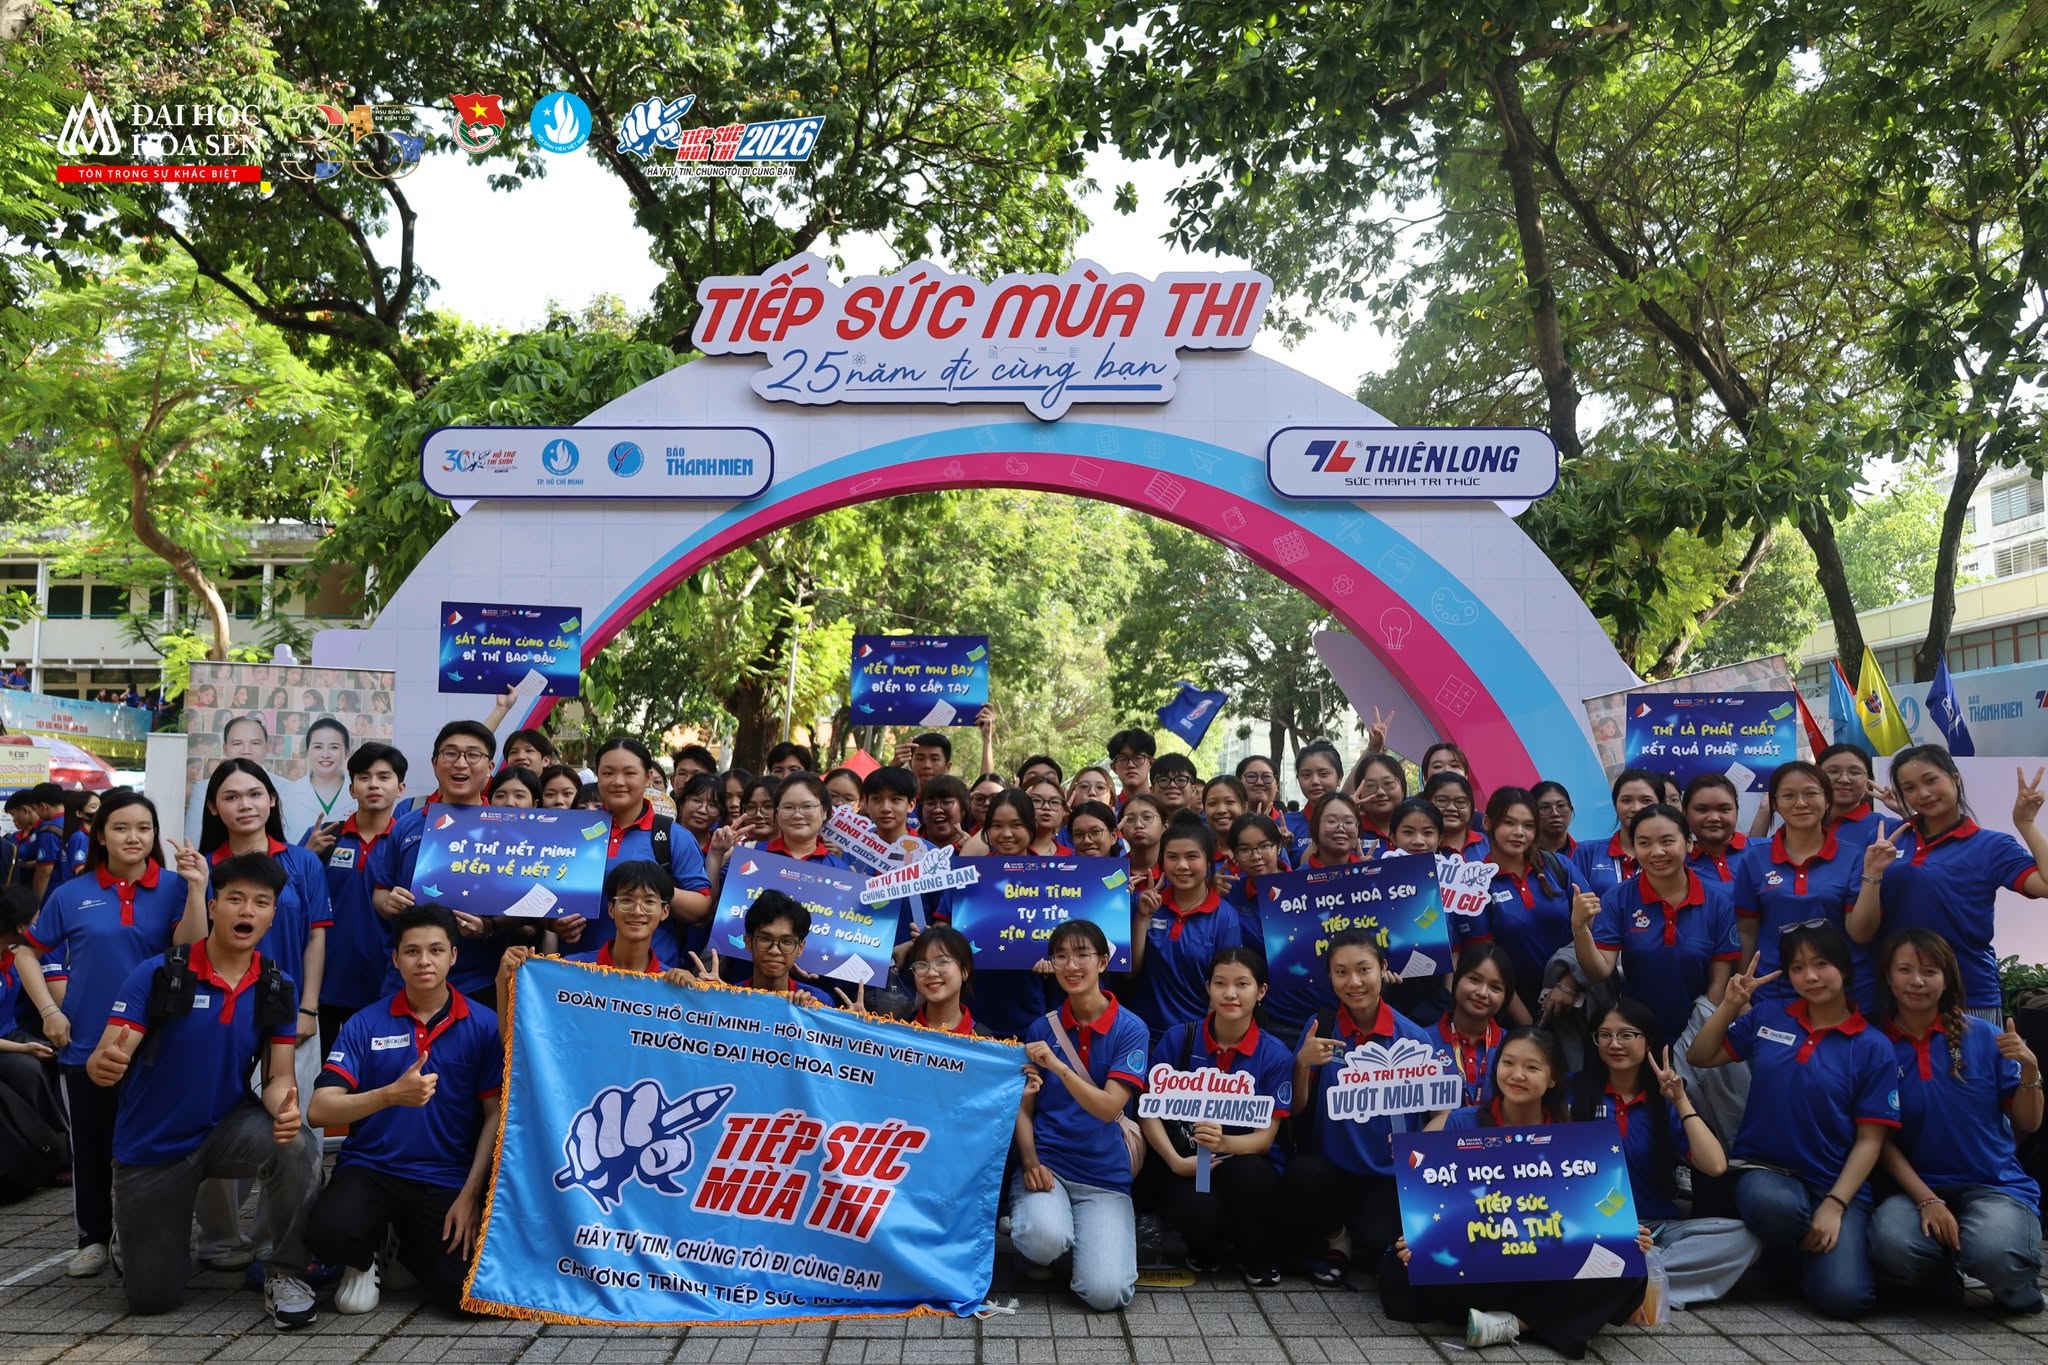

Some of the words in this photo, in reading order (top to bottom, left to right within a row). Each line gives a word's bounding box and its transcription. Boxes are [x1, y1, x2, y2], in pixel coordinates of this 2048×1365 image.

[701, 263, 825, 342] TIẾP
[835, 271, 976, 341] SỨC
[981, 271, 1148, 339] MÙA
[1164, 281, 1262, 337] THI
[767, 348, 848, 393] 25
[846, 362, 927, 383] năm
[939, 347, 977, 384] đi
[991, 355, 1090, 408] cùng
[1094, 342, 1168, 383] bạn
[666, 446, 685, 457] BÁO
[1345, 476, 1370, 487] SỨC
[1374, 478, 1416, 488] MẠNH
[1420, 478, 1442, 487] TRI
[1446, 476, 1481, 487] THỨC
[505, 651, 529, 664] BAO
[950, 664, 975, 678] BAY
[904, 682, 916, 693] 10
[947, 682, 971, 696] TAY
[1680, 721, 1696, 737] LÀ
[1740, 719, 1777, 737] CHẤT
[1641, 740, 1666, 757] KẾT
[1744, 739, 1781, 757] NHẤT
[505, 839, 535, 858] HẾT
[540, 844, 577, 860] MÌNH
[833, 819, 862, 840] BÌNH
[861, 834, 888, 855] TĨNH
[521, 860, 550, 880] HẾT
[886, 885, 900, 898] TÔI
[901, 883, 911, 895] ĐI
[913, 877, 943, 894] CÙNG
[945, 867, 976, 890] BẠN
[895, 864, 920, 883] TIN
[1004, 883, 1040, 900] BÌNH
[1315, 893, 1345, 911] HỌC
[1351, 889, 1383, 905] HOA
[1388, 884, 1418, 900] SEN
[1441, 887, 1457, 908] HI
[1457, 890, 1487, 913] CỬ
[1321, 913, 1351, 934] TIẾP
[557, 989, 608, 1011] ĐOÀN
[610, 998, 653, 1019] TNCS
[656, 1002, 682, 1023] HỒ
[685, 1005, 715, 1027] CHÍ
[717, 1013, 761, 1035] MINH
[773, 1020, 804, 1044] HỘI
[804, 1028, 845, 1050] SINH
[846, 1036, 885, 1059] VIÊN
[886, 1043, 925, 1069] VIỆT
[925, 1054, 967, 1075] NAM
[629, 1028, 710, 1058] TRƯỜNG
[712, 1041, 749, 1069] ĐẠI
[750, 1047, 792, 1074] HỌC
[794, 1054, 836, 1080] HOA
[837, 1062, 876, 1087] SEN
[1153, 1067, 1206, 1095] Good
[1207, 1072, 1251, 1096] luck
[1343, 1069, 1371, 1085] TÒA
[1373, 1069, 1395, 1082] TRI
[1397, 1063, 1439, 1080] THỨC
[1142, 1098, 1161, 1114] TO
[1164, 1098, 1203, 1118] YOUR
[1203, 1099, 1270, 1125] EXAMS!!!
[1332, 1085, 1379, 1118] VƯỢT
[1383, 1079, 1425, 1111] MÙA
[1429, 1080, 1457, 1106] THI
[716, 1112, 823, 1166] TIẾP
[822, 1121, 928, 1182] SỨC
[1423, 1161, 1460, 1188] ĐẠI
[1467, 1164, 1506, 1186] HỌC
[1512, 1160, 1554, 1181] HOA
[1560, 1158, 1599, 1179] SEN
[694, 1163, 809, 1222] MÙA
[809, 1179, 892, 1240] THI
[1475, 1190, 1513, 1215] TIẾP
[1467, 1215, 1519, 1243] MÙA
[1522, 1210, 1565, 1240] THI
[575, 1225, 611, 1247] HÃY
[615, 1229, 639, 1254] TỰ
[641, 1236, 672, 1259] TIN,
[676, 1240, 735, 1268] CHÚNG
[740, 1246, 770, 1271] TÔI
[773, 1252, 792, 1273] ĐI
[792, 1253, 846, 1284] CÙNG
[843, 1268, 882, 1293] BẠN
[1501, 1241, 1538, 1256] 2026
[557, 1256, 641, 1290] CHƯƠNG
[647, 1270, 708, 1299] TRÌNH
[713, 1282, 759, 1306] TIẾP
[764, 1287, 808, 1307] SỨC
